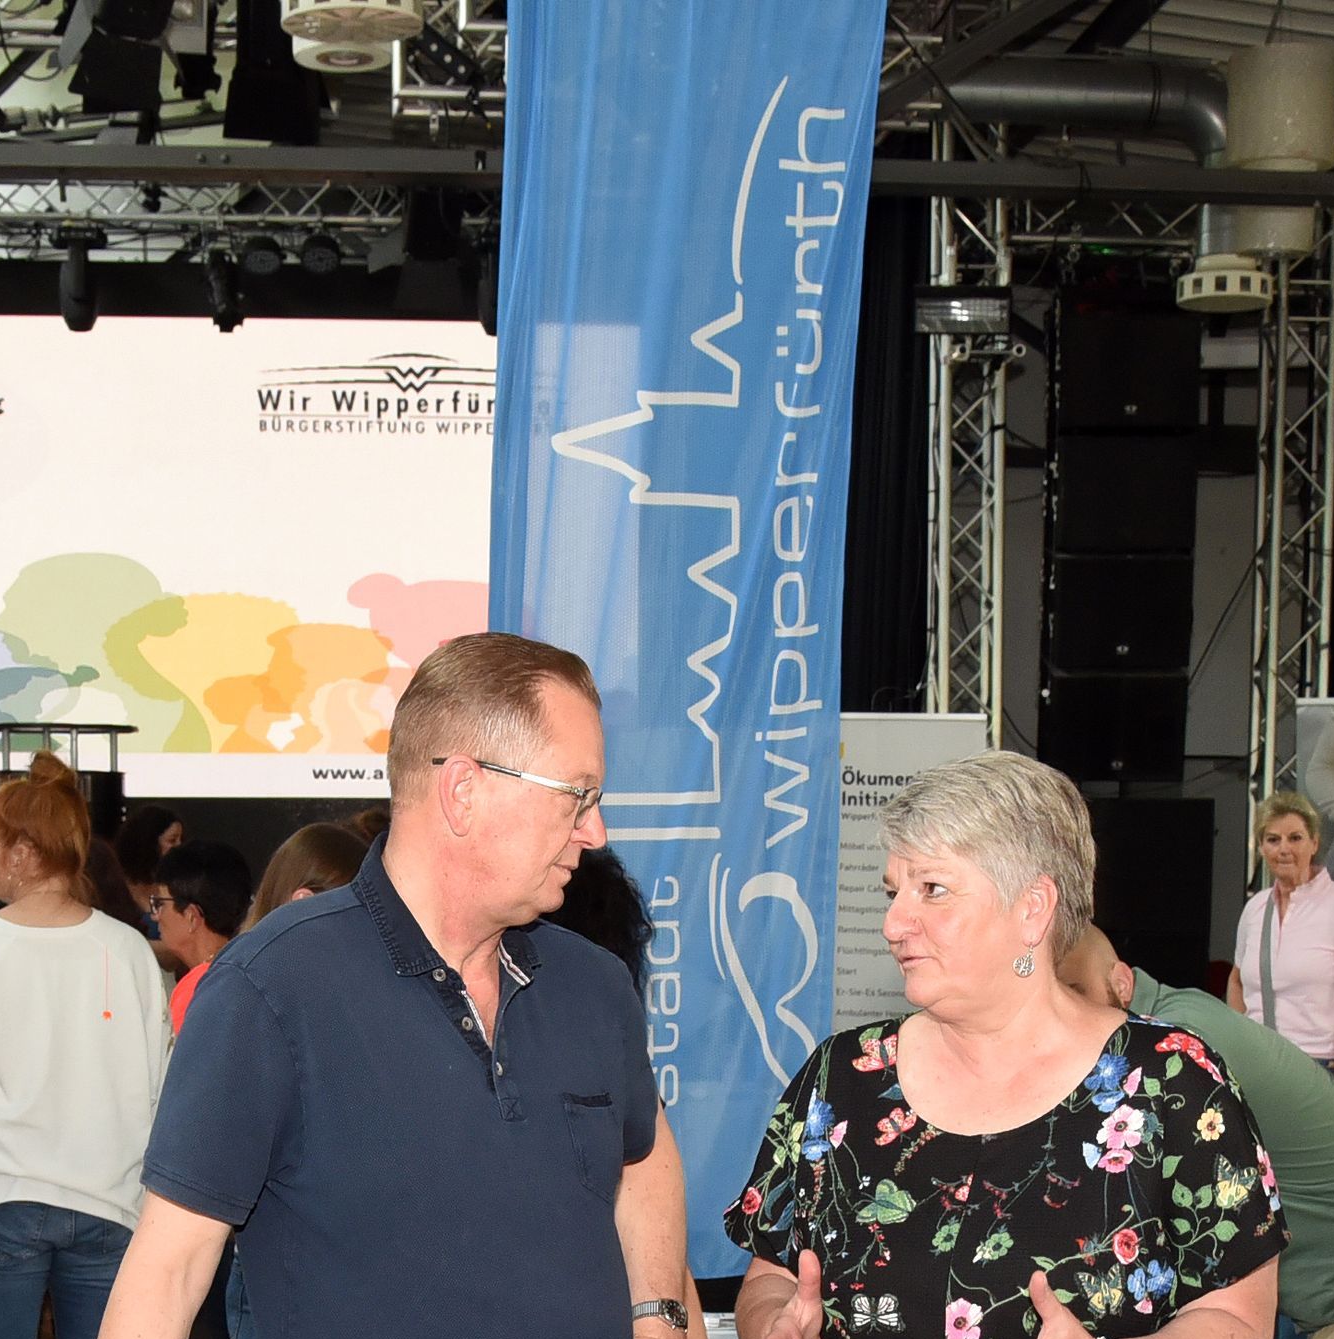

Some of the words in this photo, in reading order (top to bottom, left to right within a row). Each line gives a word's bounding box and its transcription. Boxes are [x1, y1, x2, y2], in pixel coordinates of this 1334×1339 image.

[257, 390, 311, 412] Wir
[332, 389, 496, 419] Wipperfür
[259, 416, 426, 434] BÜRGERSTIFTUNG
[436, 421, 494, 435] WIPPE
[755, 106, 846, 850] wipperfürth
[312, 767, 389, 780] www.a
[842, 766, 921, 786] Ökumen
[841, 791, 894, 806] Initia
[841, 813, 877, 821] Wipperf
